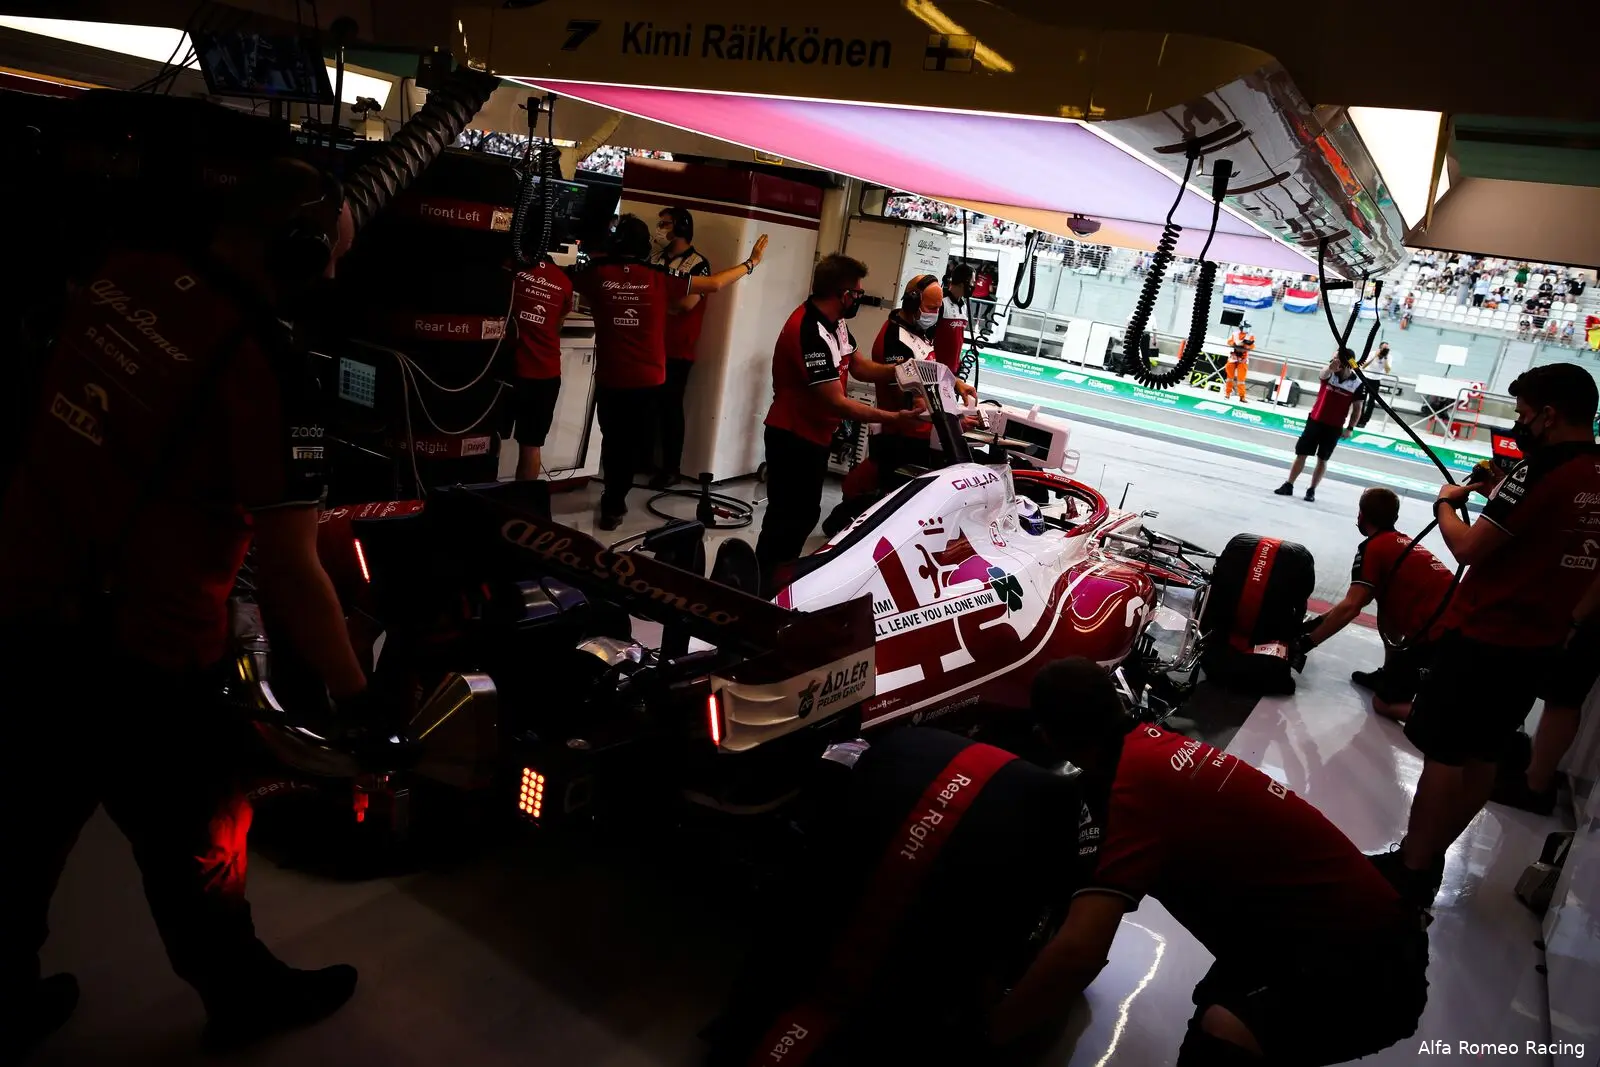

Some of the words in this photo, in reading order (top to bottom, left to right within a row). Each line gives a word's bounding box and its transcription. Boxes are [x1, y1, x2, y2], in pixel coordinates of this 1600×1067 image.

[561, 19, 601, 51] 7
[622, 21, 692, 57] Kimi
[702, 23, 891, 68] Räikkönen
[420, 203, 455, 219] Front
[458, 207, 480, 222] Left
[525, 287, 551, 300] RACING
[89, 279, 132, 315] Alfa
[126, 308, 195, 363] Romeo
[415, 320, 445, 333] Rear
[448, 322, 470, 334] Left
[521, 312, 544, 323] ORLEN
[84, 325, 140, 376] RACING
[415, 440, 449, 454] Right
[500, 518, 590, 574] Alfa
[592, 550, 739, 626] Romeo
[1252, 560, 1267, 582] Right
[888, 613, 921, 632] LEAVE
[921, 608, 942, 621] YOU
[944, 598, 973, 616] ALONE
[974, 593, 994, 606] NOW
[820, 661, 868, 697] ADLER
[817, 691, 842, 711] PELZER
[1170, 744, 1196, 771] Alfa
[936, 773, 972, 809] Rear
[900, 809, 945, 860] Right
[769, 1021, 809, 1063] Rear
